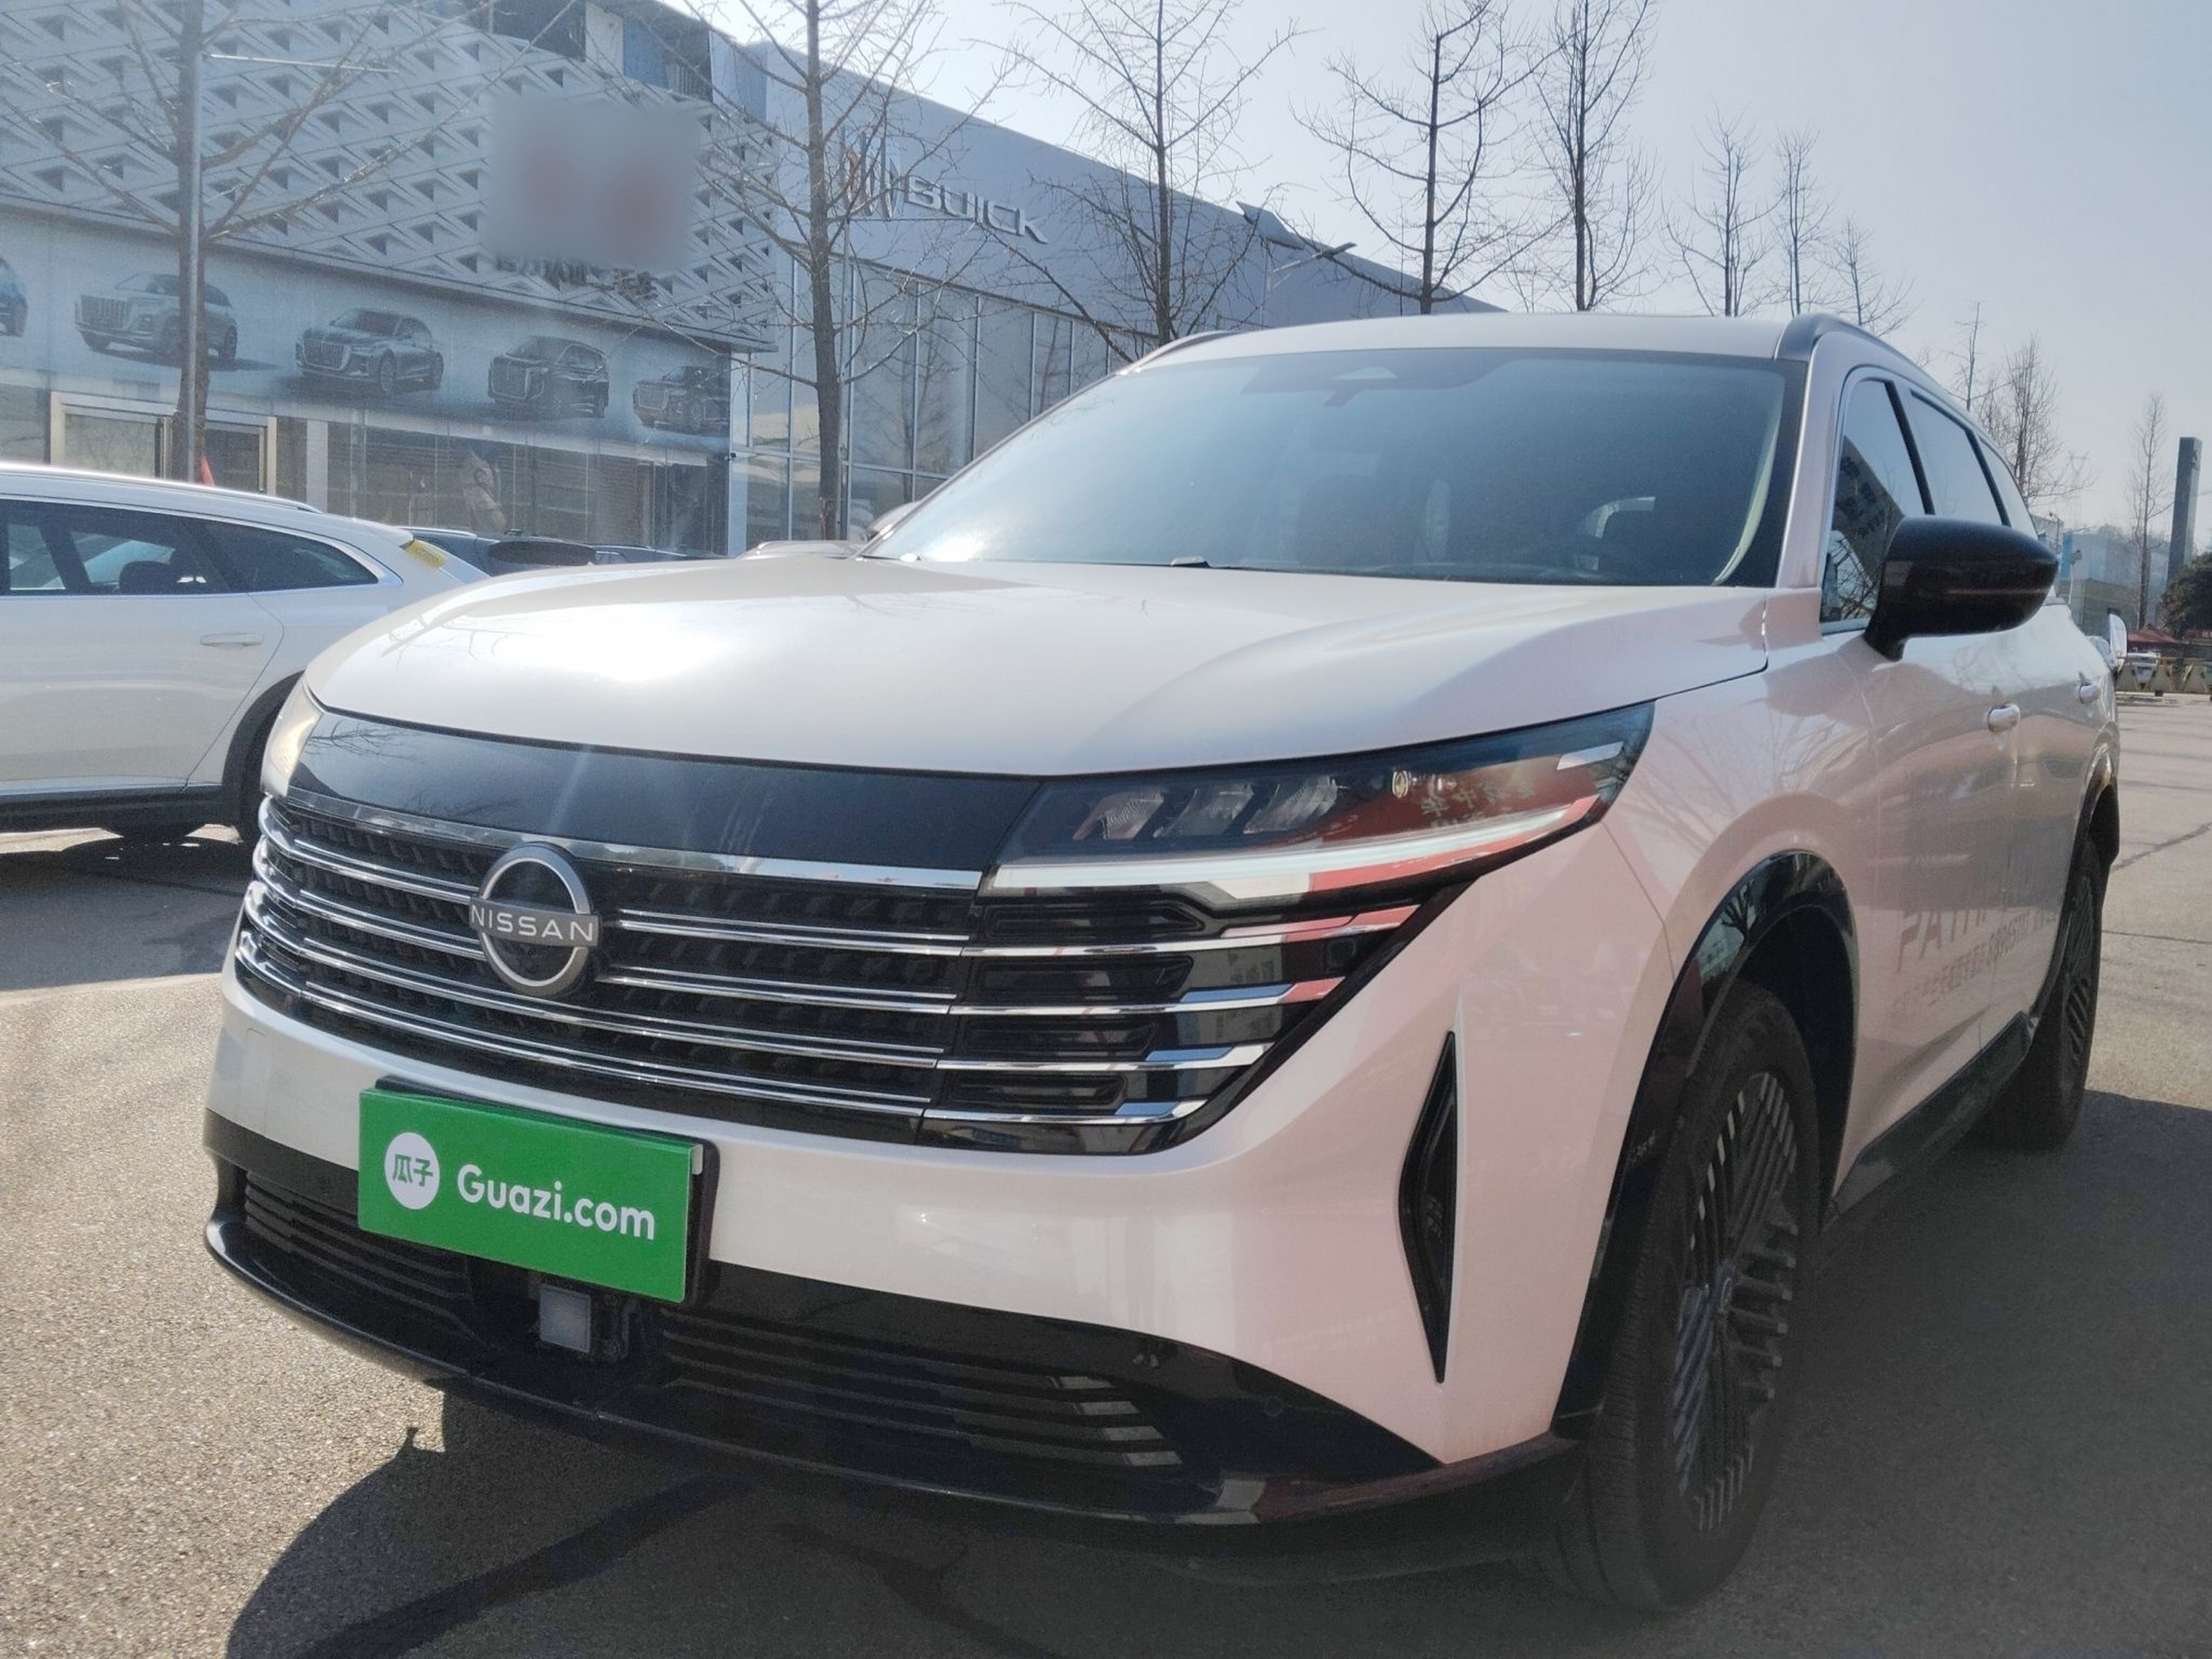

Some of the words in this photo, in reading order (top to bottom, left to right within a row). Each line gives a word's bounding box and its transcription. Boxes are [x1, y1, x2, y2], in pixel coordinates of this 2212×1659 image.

[905, 174, 1048, 244] BUICK
[471, 904, 593, 942] NISSAN
[392, 1153, 433, 1187] 瓜子
[457, 1164, 656, 1241] Guazi.com
